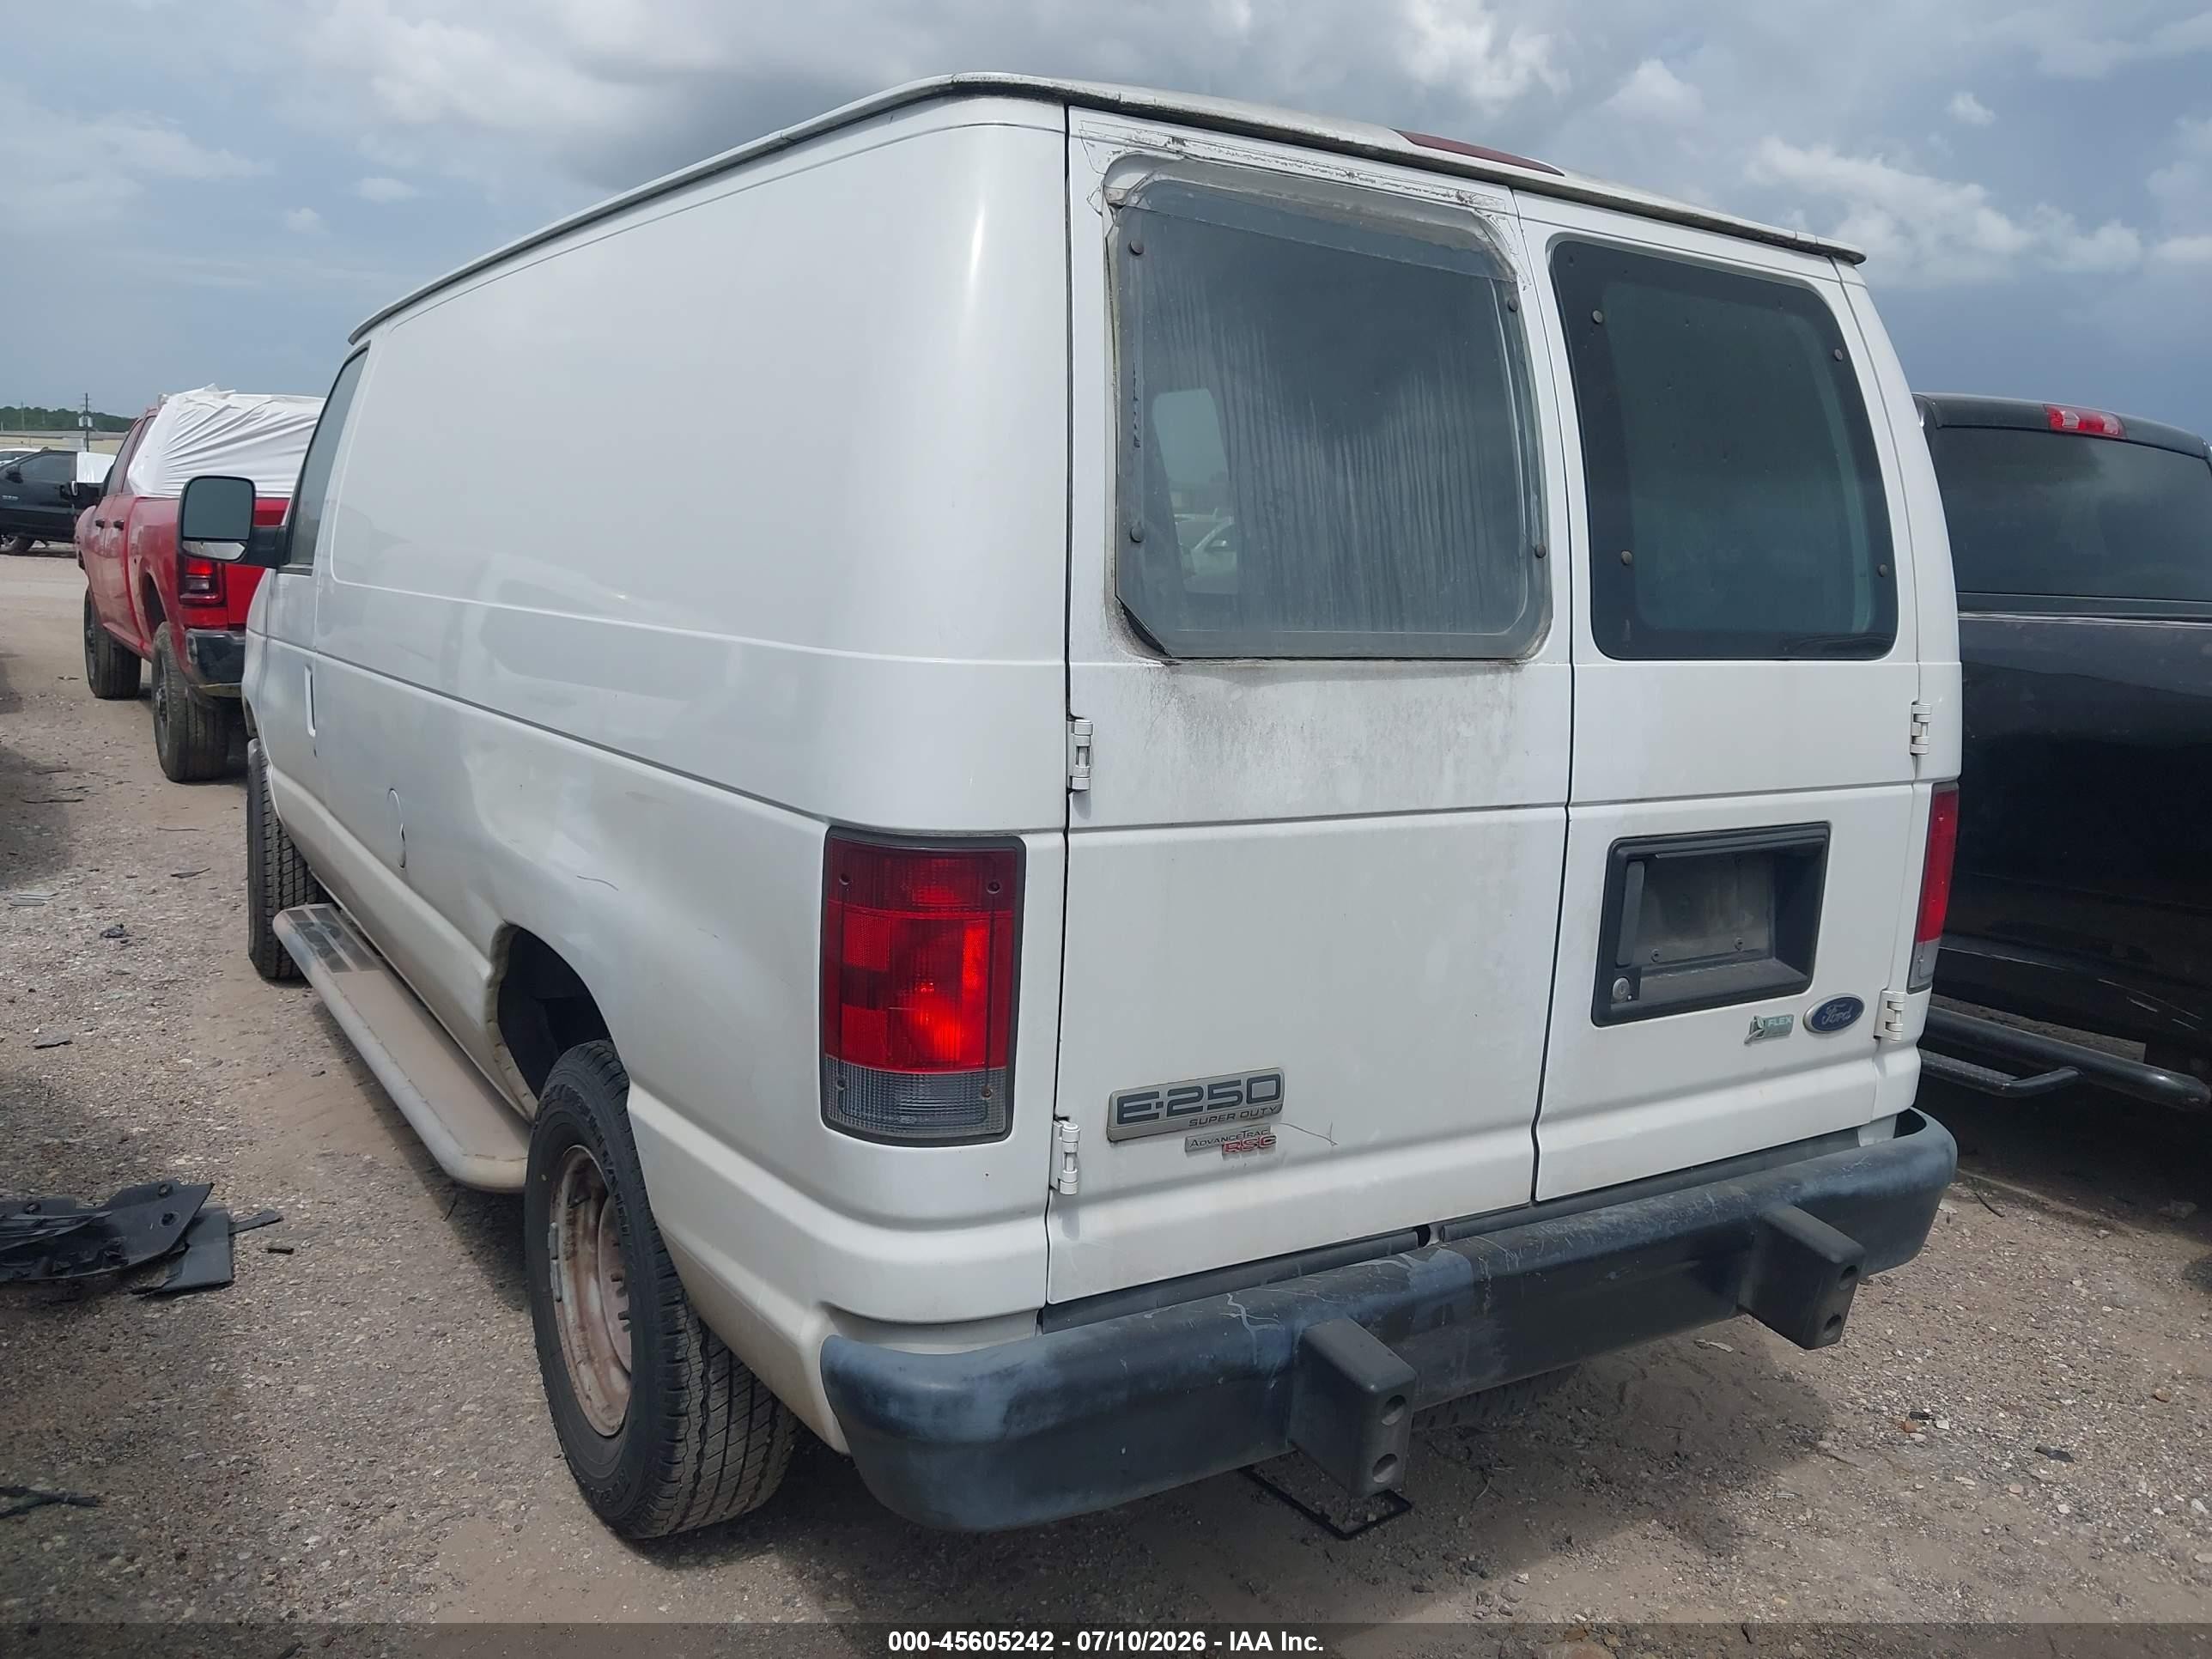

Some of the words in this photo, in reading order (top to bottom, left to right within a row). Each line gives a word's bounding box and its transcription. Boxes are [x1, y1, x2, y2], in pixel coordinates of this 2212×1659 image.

[1768, 1016, 1793, 1028] FLEX
[1822, 1003, 1851, 1025] Ford
[1117, 1073, 1281, 1125] E-250
[1188, 1113, 1237, 1127] SUPER
[1240, 1106, 1278, 1119] DUTY
[1223, 1134, 1277, 1154] RSC
